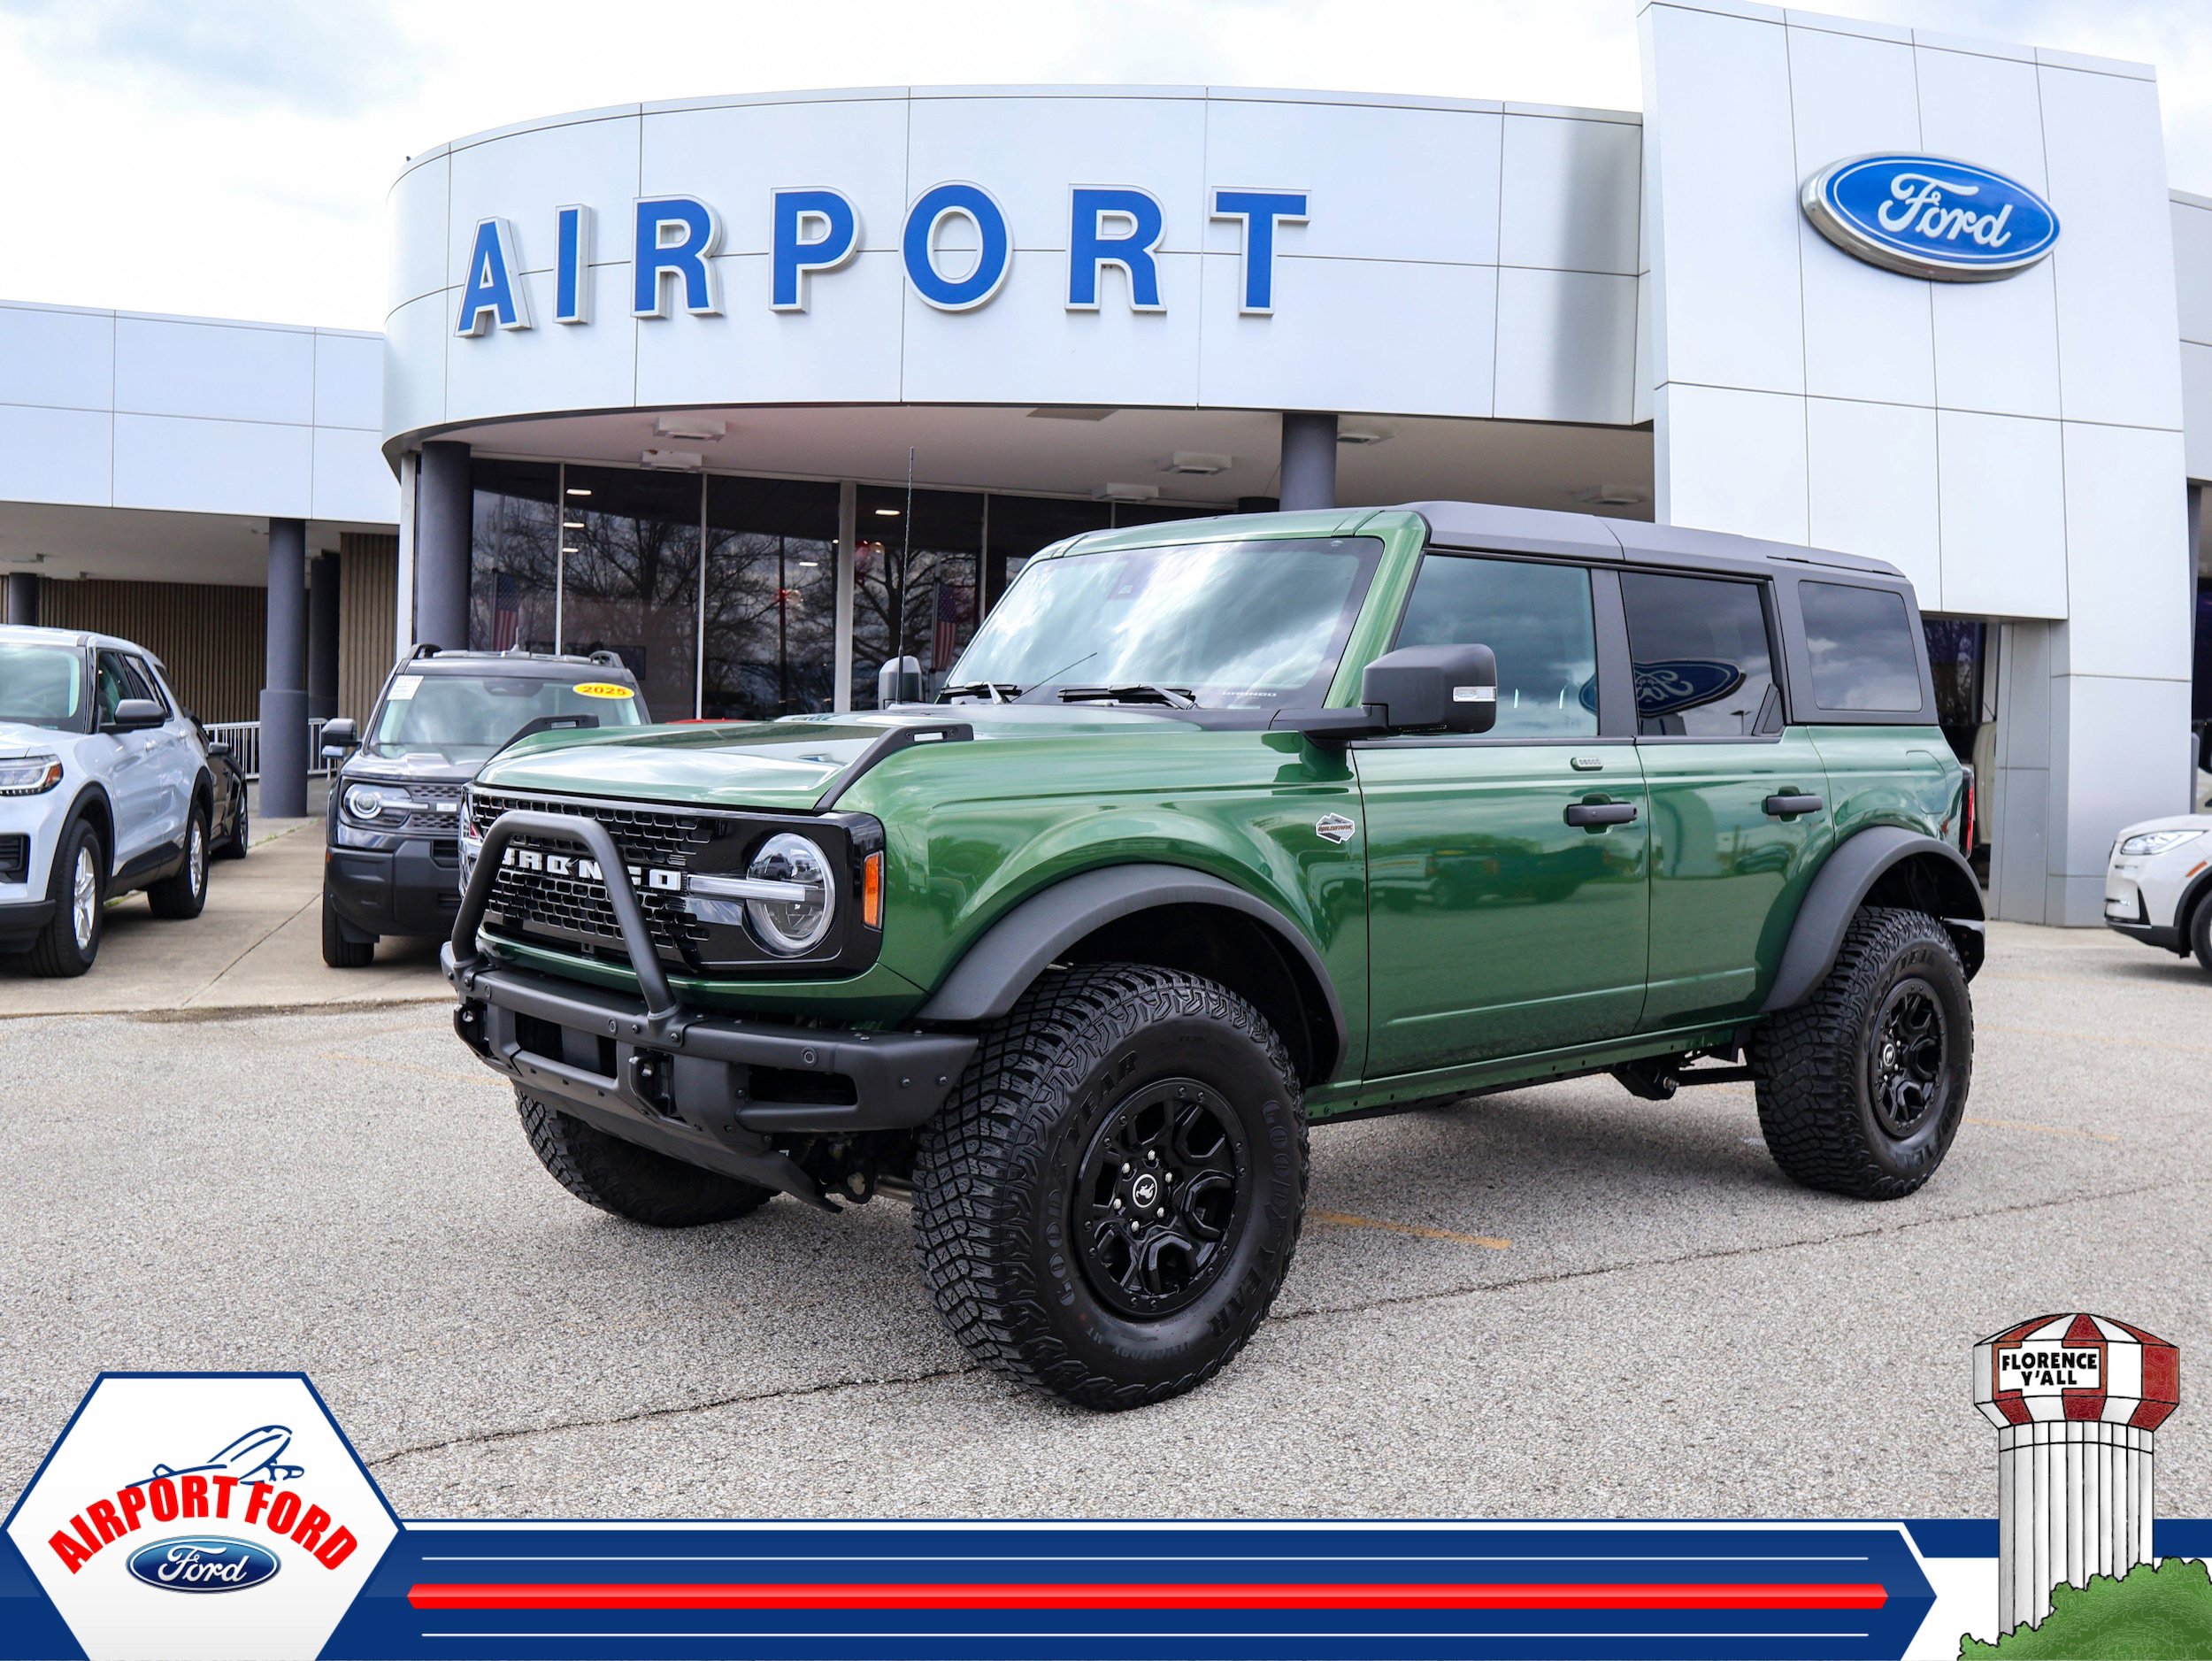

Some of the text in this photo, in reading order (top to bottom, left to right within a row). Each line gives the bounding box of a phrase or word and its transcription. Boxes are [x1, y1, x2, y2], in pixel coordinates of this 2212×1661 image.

[1878, 173, 2014, 248] Ford
[454, 180, 1310, 338] AIRPORT
[582, 686, 626, 696] 2025
